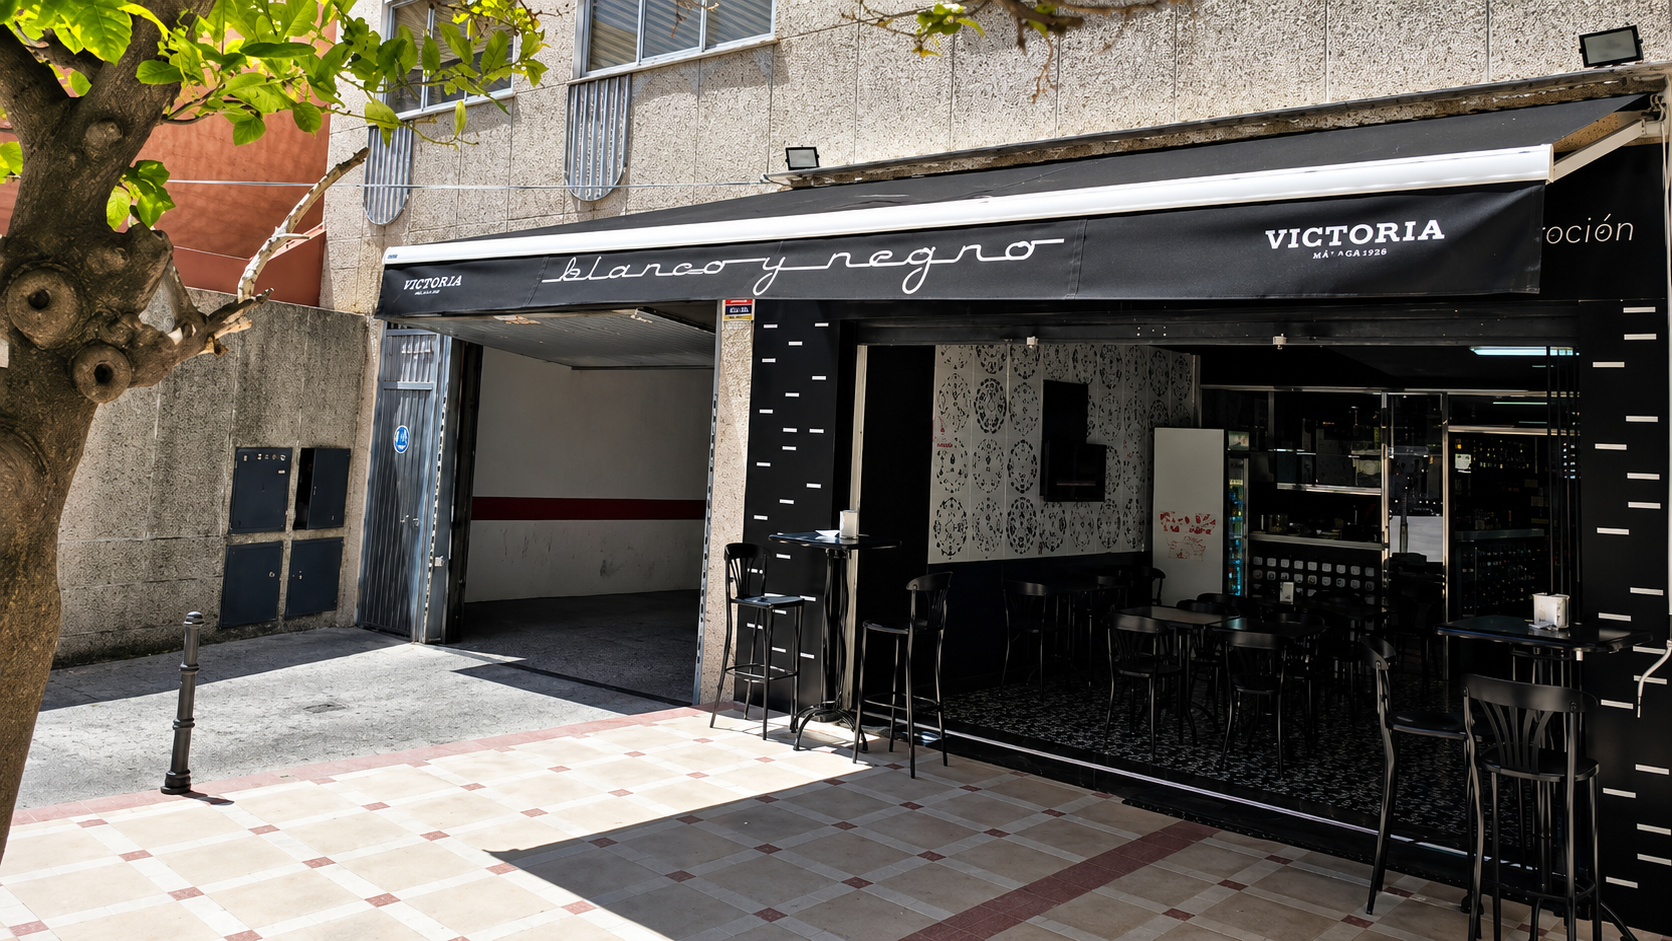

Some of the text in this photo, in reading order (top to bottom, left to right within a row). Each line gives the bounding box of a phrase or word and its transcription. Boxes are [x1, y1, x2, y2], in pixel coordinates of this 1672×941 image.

[1265, 219, 1445, 249] VICTORIA
[1541, 213, 1634, 245] oción
[541, 238, 1064, 296] blanco y negro
[1312, 249, 1360, 259] MÁAGA
[403, 275, 462, 290] VICTORIA
